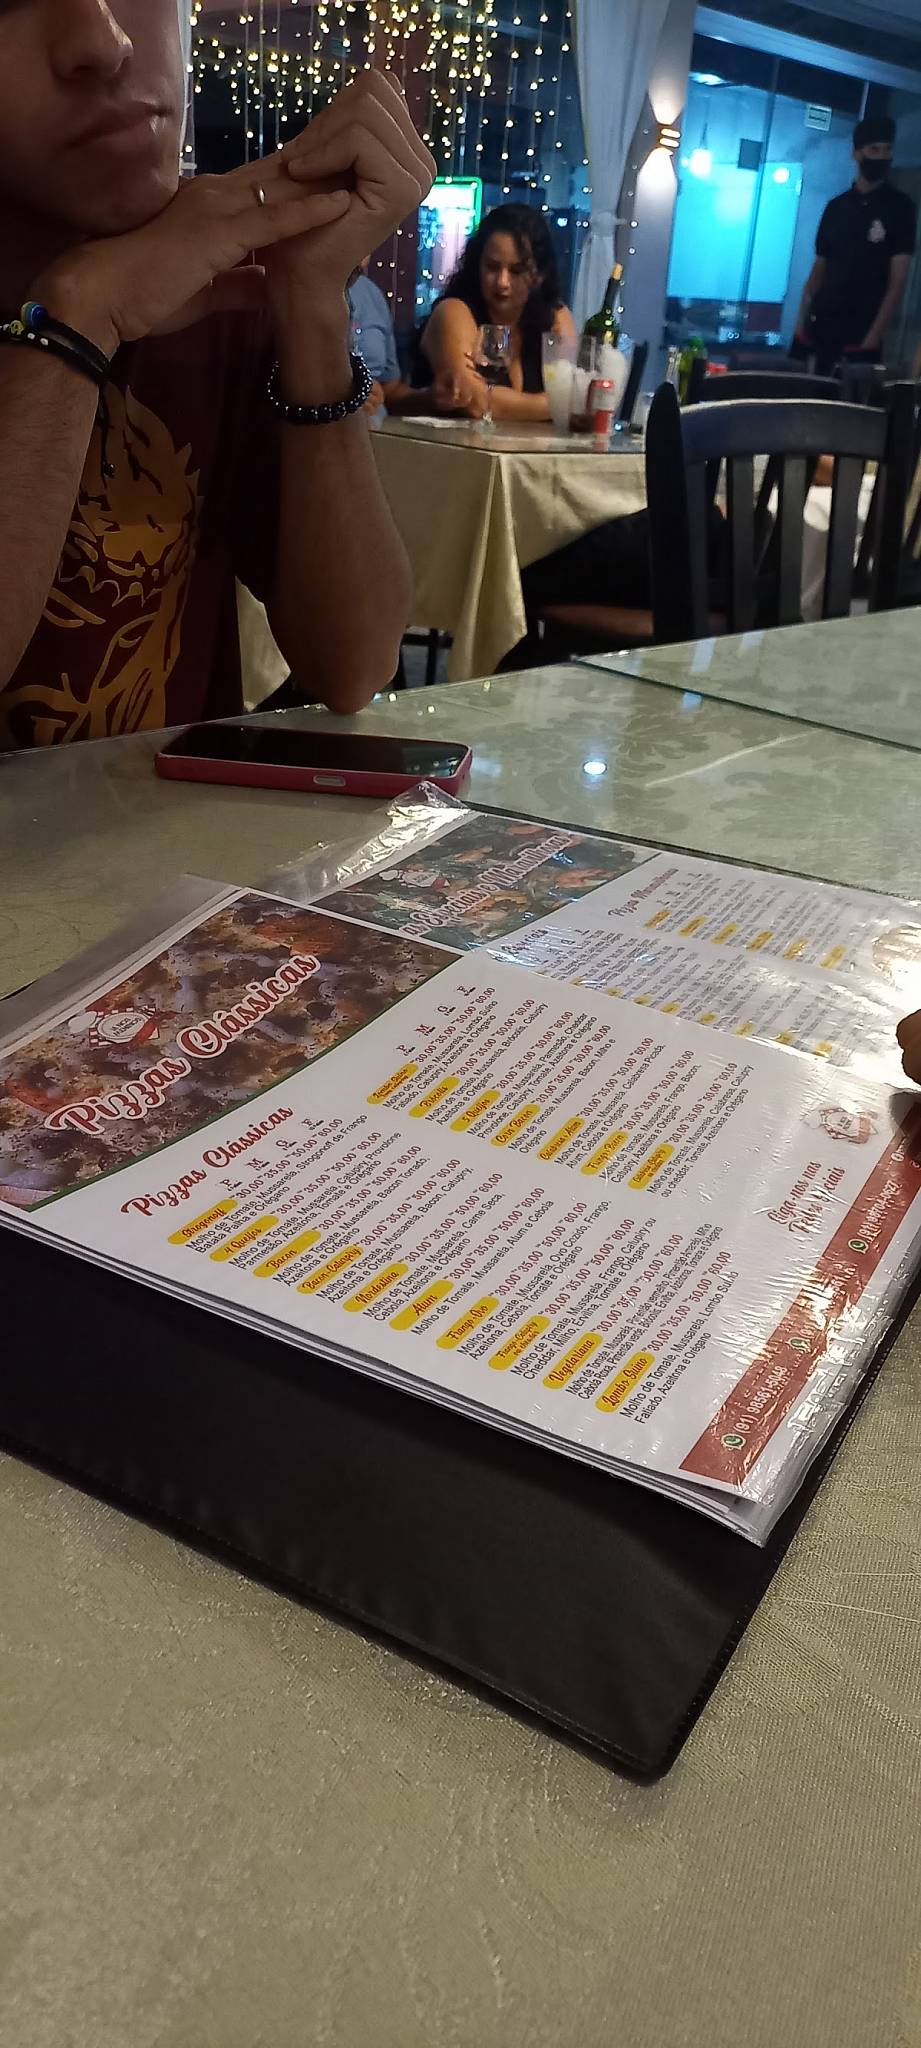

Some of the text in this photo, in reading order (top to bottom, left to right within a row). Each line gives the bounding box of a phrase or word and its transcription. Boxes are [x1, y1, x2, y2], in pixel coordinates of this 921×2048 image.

[46, 955, 319, 1134] Pizzas Clássicas
[395, 1044, 407, 1052] P
[415, 1024, 430, 1034] M
[437, 1005, 449, 1013] G
[434, 1025, 457, 1044] 35,00
[475, 987, 496, 1004] 60,00
[456, 999, 535, 1076] 30,00 35,00 50,00 60,00
[597, 1078, 618, 1097] 35,00
[121, 1108, 293, 1216] Pizzas Clássicas
[185, 1230, 216, 1250] Molho
[223, 1200, 261, 1222] Tomate,
[255, 1170, 300, 1200] Mussarela,
[296, 1141, 335, 1170] Strogonoff
[339, 1115, 368, 1135] Frango
[219, 1118, 313, 1187] P M G F
[235, 1118, 343, 1199] 30,00 35,00 50,00 60,00
[276, 1132, 382, 1214] 30,00 35,00 50,00 60,00
[318, 1145, 422, 1230] 30,00 35,00 50,00 60,00
[802, 1161, 822, 1180] nas
[228, 1247, 259, 1268] Molho
[266, 1216, 303, 1238] Tomate,
[297, 1186, 338, 1216] Mussarela,
[336, 1160, 371, 1185] Catupiry,
[365, 1132, 402, 1160] Provolone
[273, 1262, 303, 1283] Molho
[309, 1231, 345, 1254] Tomate,
[339, 1199, 383, 1231] Mussarela,
[377, 1179, 403, 1199] Bacon
[398, 1158, 431, 1179] Torrado,
[317, 1279, 346, 1300] Molho
[351, 1247, 387, 1270] Tomate,
[381, 1214, 424, 1246] Mussarela,
[418, 1193, 447, 1213] Bacon,
[441, 1167, 474, 1192] Catupiry,
[360, 1159, 461, 1246] 30,00 35,00 50,00 60,00
[404, 1173, 503, 1262] 30,00 35,00 50,00 60,00
[449, 1187, 545, 1279] 30,00 35,00 50,00 60,00
[266, 1250, 297, 1269] Bacon
[364, 1297, 392, 1320] Molho
[398, 1264, 433, 1288] Tomate,
[425, 1230, 468, 1264] Mussarela,
[462, 1210, 486, 1229] Carne
[481, 1194, 505, 1210] Seca,
[412, 1314, 440, 1336] Molho
[444, 1281, 479, 1305] Tomate,
[471, 1246, 513, 1280] Mussarela,
[507, 1227, 529, 1246] Atum
[528, 1200, 554, 1222] Cebola
[497, 1202, 587, 1296] 30,00 35,00 50,00 60,00
[544, 1219, 635, 1315] 30,00 35,00 50,00 60,00
[596, 1309, 622, 1332] 30,00
[660, 1234, 684, 1256] 60,00
[412, 1295, 438, 1316] Atum
[647, 1251, 731, 1352] 30,00 35,00 50,00 60,00
[602, 1380, 630, 1407] Lombo
[634, 1396, 666, 1424] Fatiado,
[657, 1364, 687, 1395] Azeitona
[684, 1332, 712, 1359] Orégano
[733, 1365, 788, 1434] (91) 98561-5048
